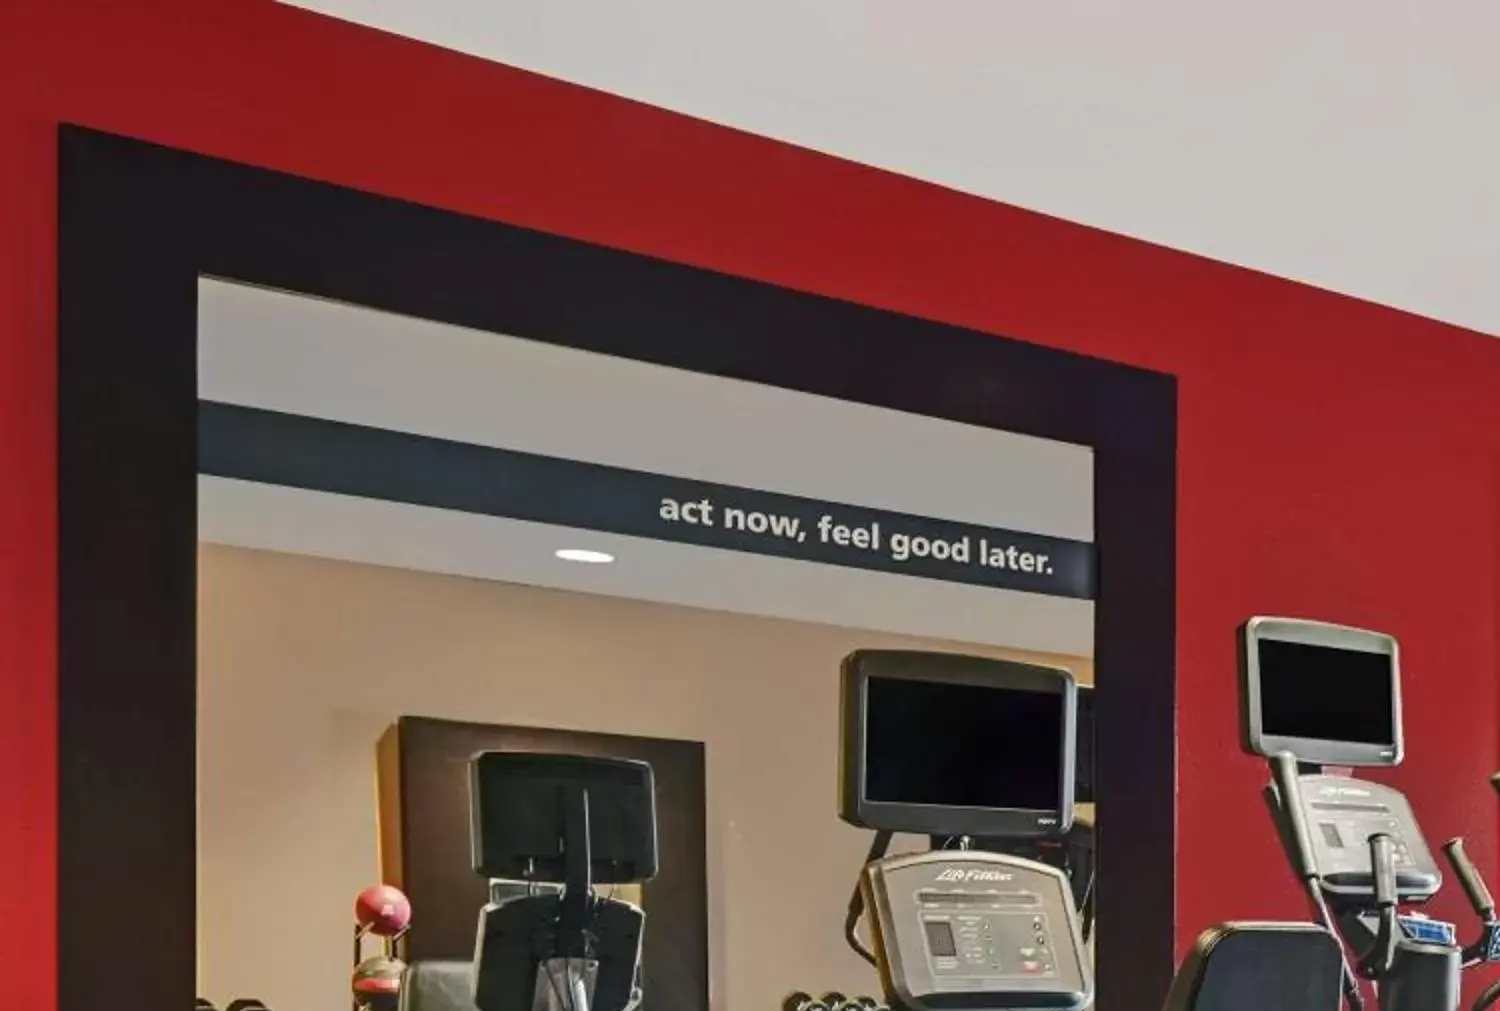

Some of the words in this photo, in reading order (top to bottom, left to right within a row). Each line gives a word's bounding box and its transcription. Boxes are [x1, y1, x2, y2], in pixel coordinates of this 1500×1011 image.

[659, 496, 713, 527] act
[723, 503, 807, 543] now,
[817, 516, 880, 550] feel
[890, 532, 970, 562] good
[979, 540, 1054, 575] later.
